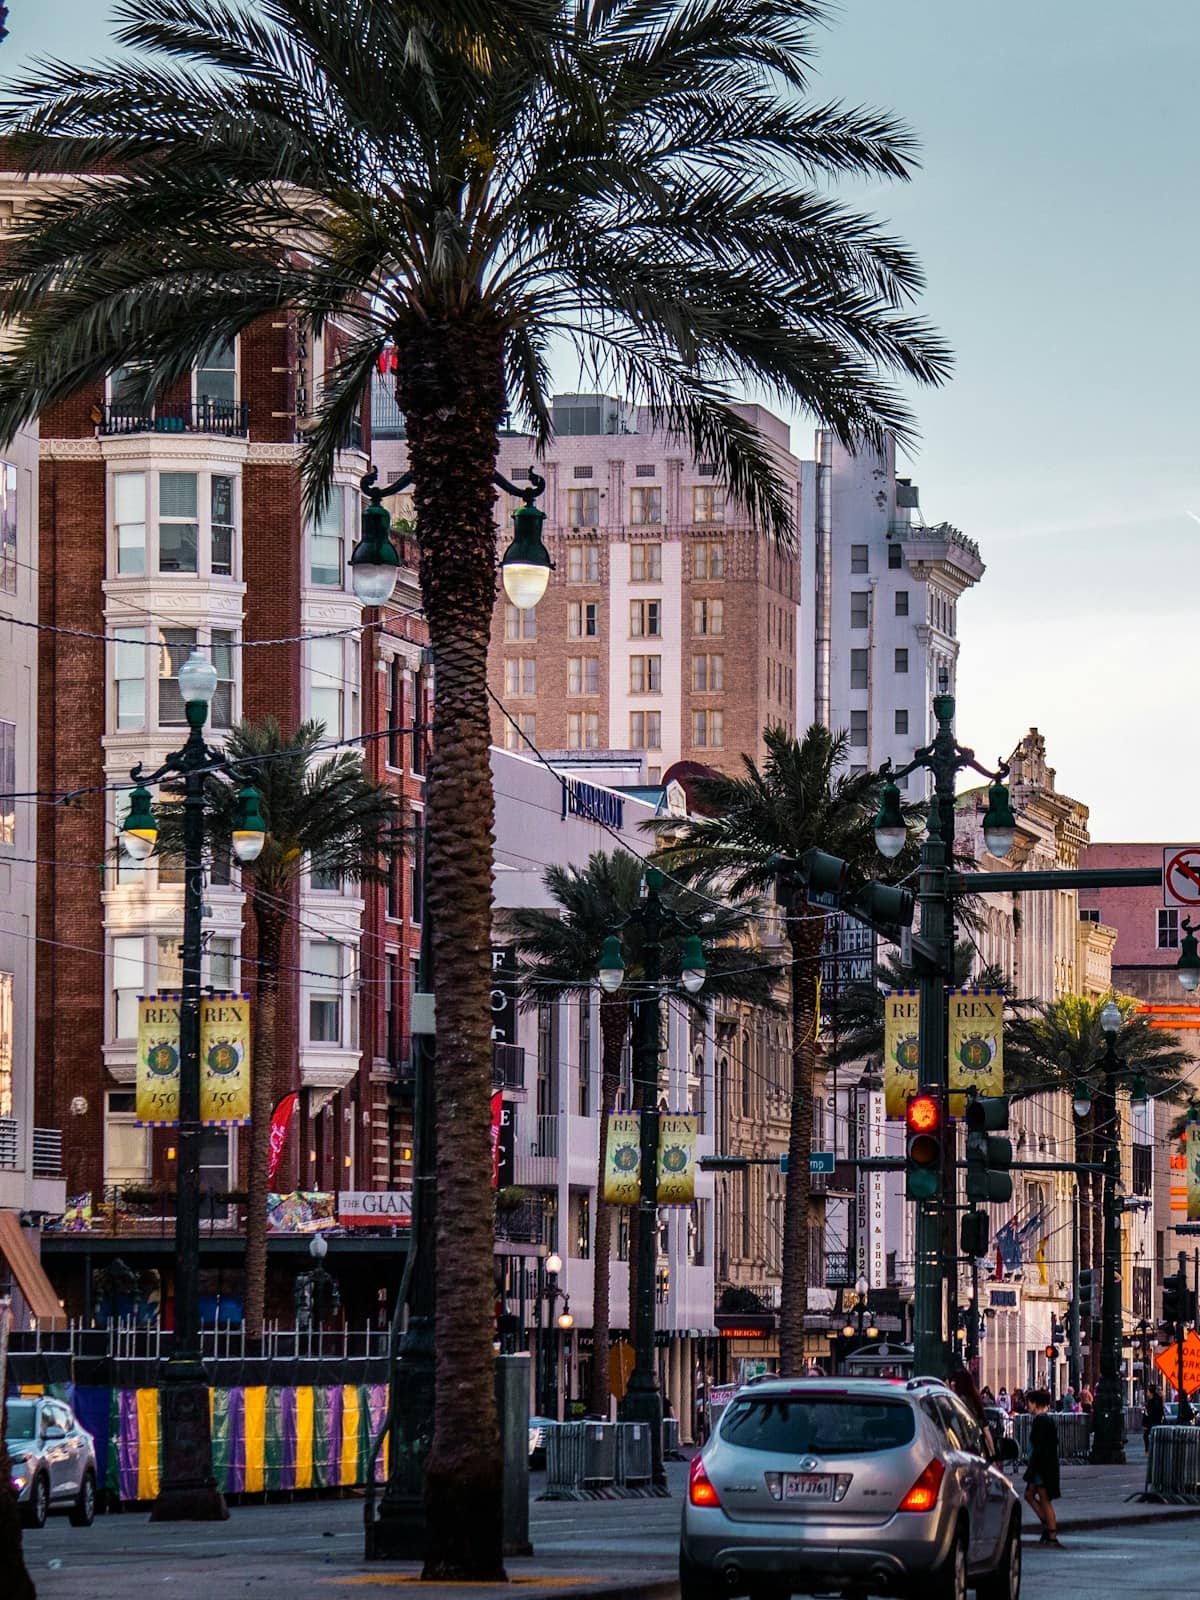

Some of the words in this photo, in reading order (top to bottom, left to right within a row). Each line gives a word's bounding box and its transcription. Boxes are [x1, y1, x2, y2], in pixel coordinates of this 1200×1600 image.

[145, 1008, 181, 1023] REX
[205, 1007, 243, 1022] REX
[893, 1003, 919, 1018] RE
[955, 1003, 996, 1018] REX
[152, 1092, 176, 1107] 150
[212, 1092, 237, 1107] 150
[662, 1121, 691, 1132] REX
[858, 1103, 866, 1228] ESTABISHED
[664, 1185, 684, 1196] 150
[342, 1200, 361, 1209] THE
[362, 1195, 412, 1213] GIAN
